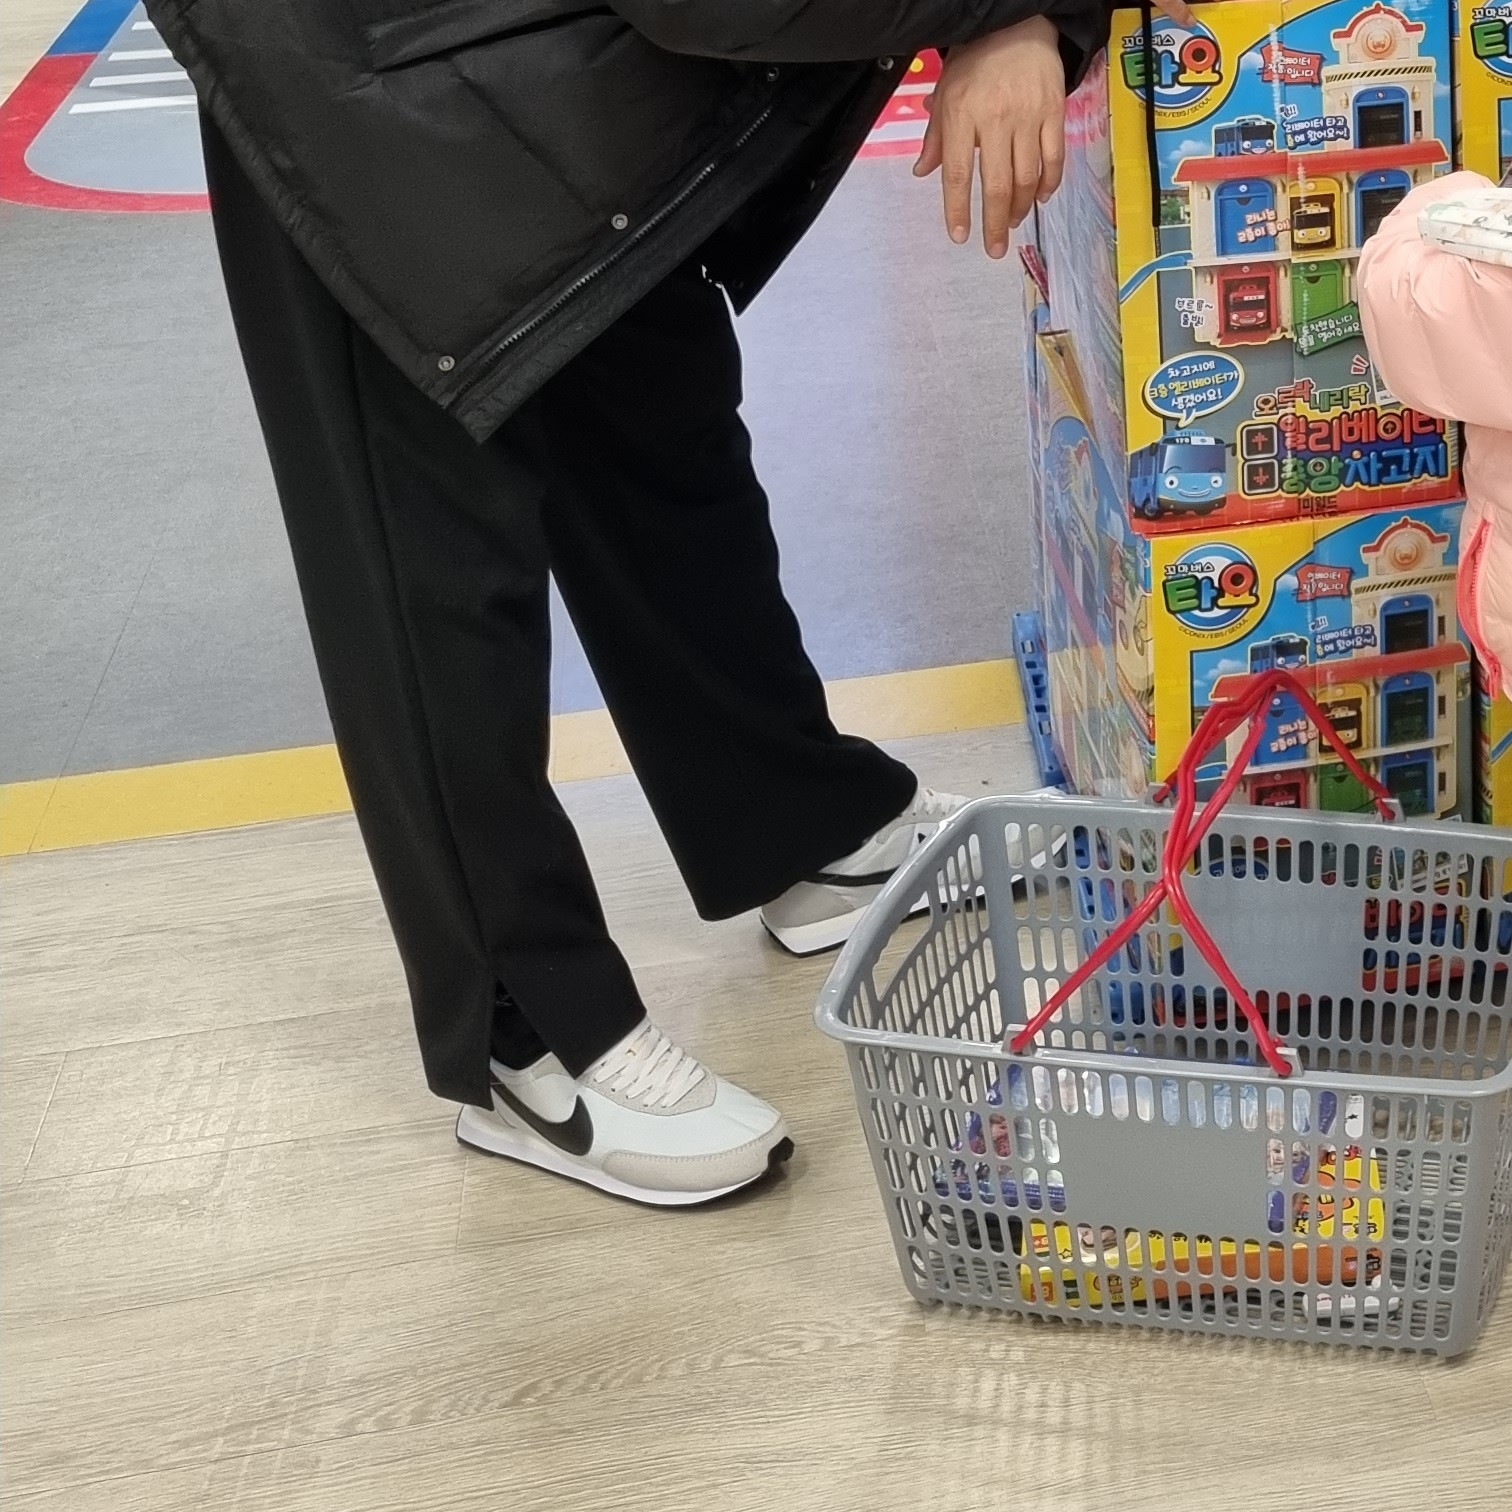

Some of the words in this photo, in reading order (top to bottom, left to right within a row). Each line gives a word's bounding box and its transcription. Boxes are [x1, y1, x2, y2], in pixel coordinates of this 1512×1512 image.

[1120, 34, 1224, 89] 타요
[1167, 360, 1217, 379] 차고지에
[1170, 388, 1223, 410] 생겼어요!
[1254, 378, 1314, 417] 오르락
[1310, 384, 1370, 413] 내리락
[1164, 562, 1215, 576] 꼬마버스
[1161, 562, 1260, 614] 타요
